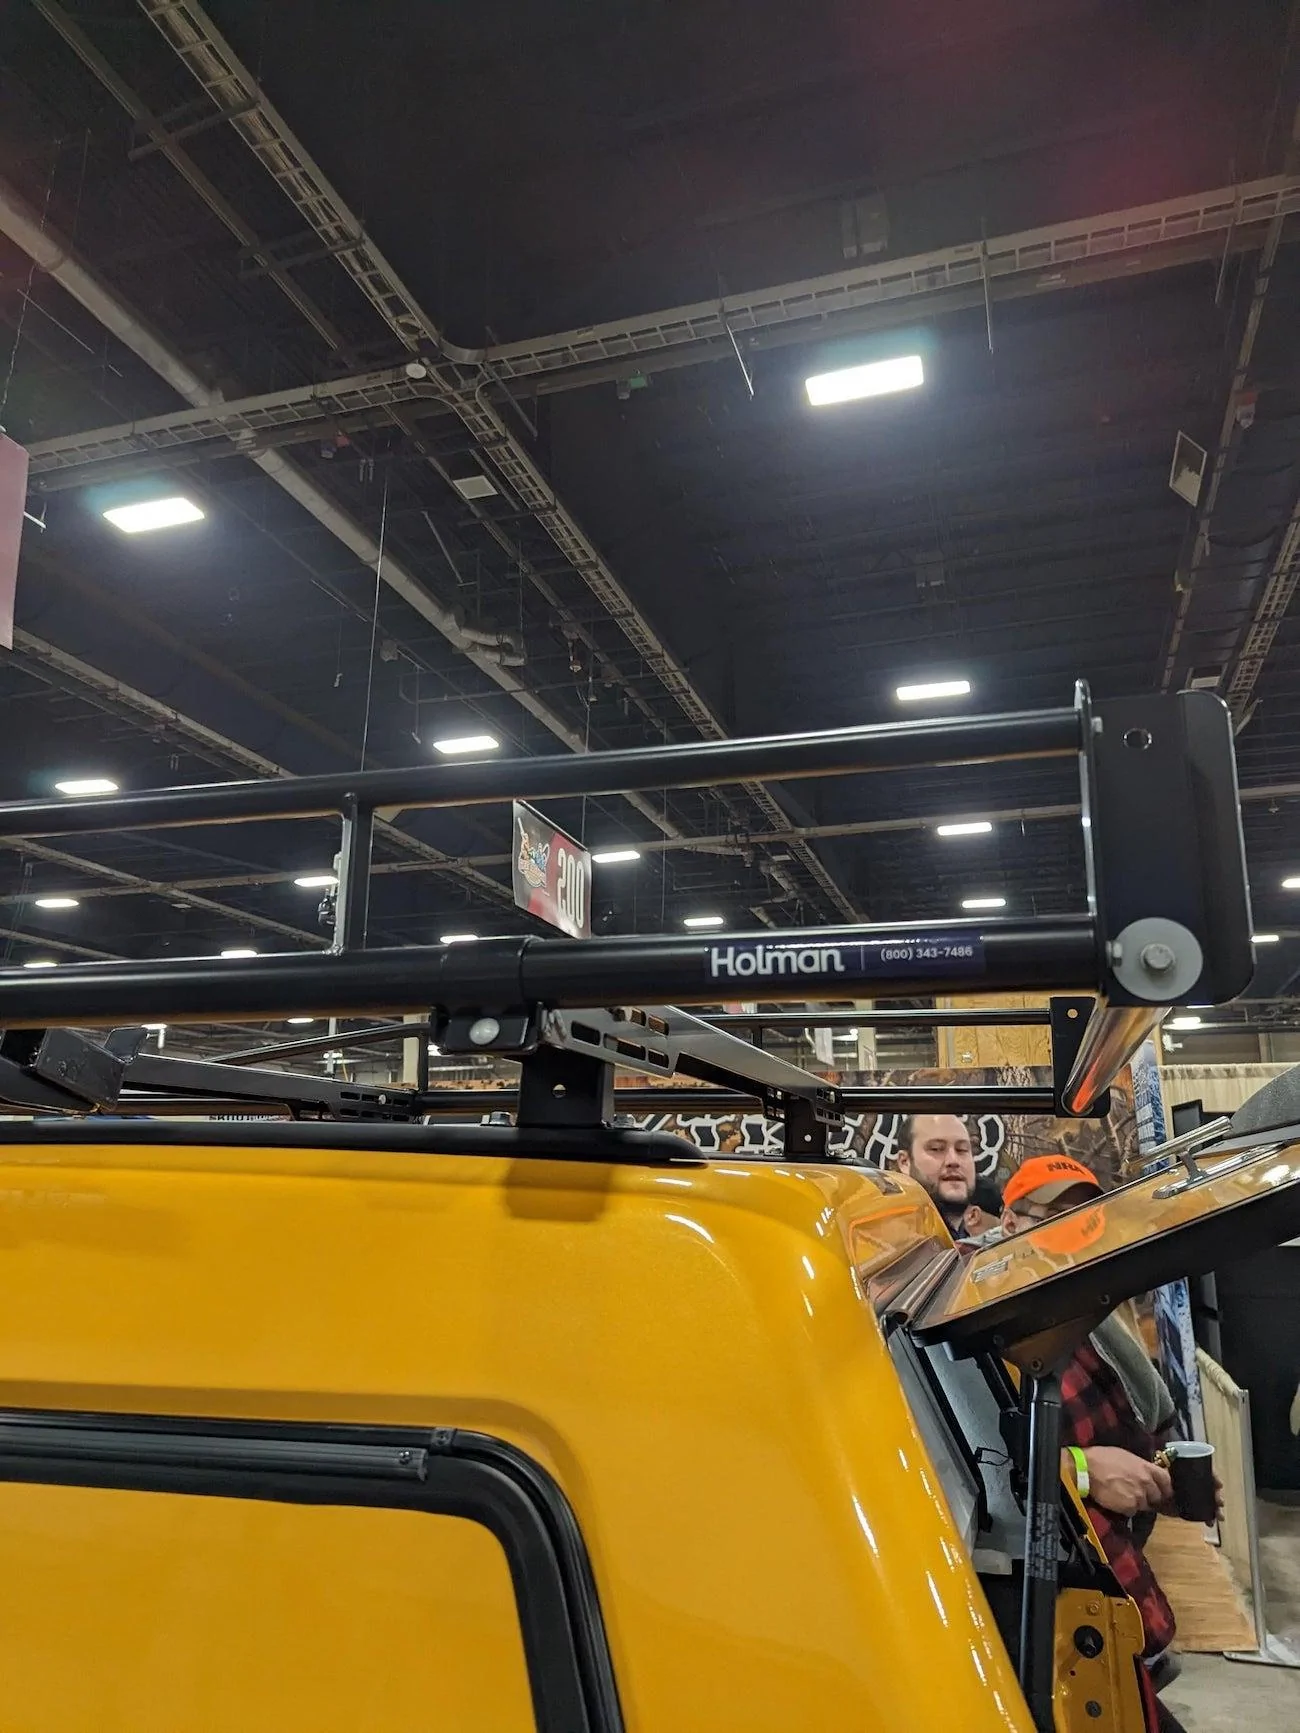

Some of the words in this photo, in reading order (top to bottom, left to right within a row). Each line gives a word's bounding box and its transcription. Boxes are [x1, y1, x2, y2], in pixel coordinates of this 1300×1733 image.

[557, 848, 585, 928] 200
[711, 945, 844, 977] Holman
[880, 947, 913, 961] (800)
[916, 945, 973, 958] 343-7486
